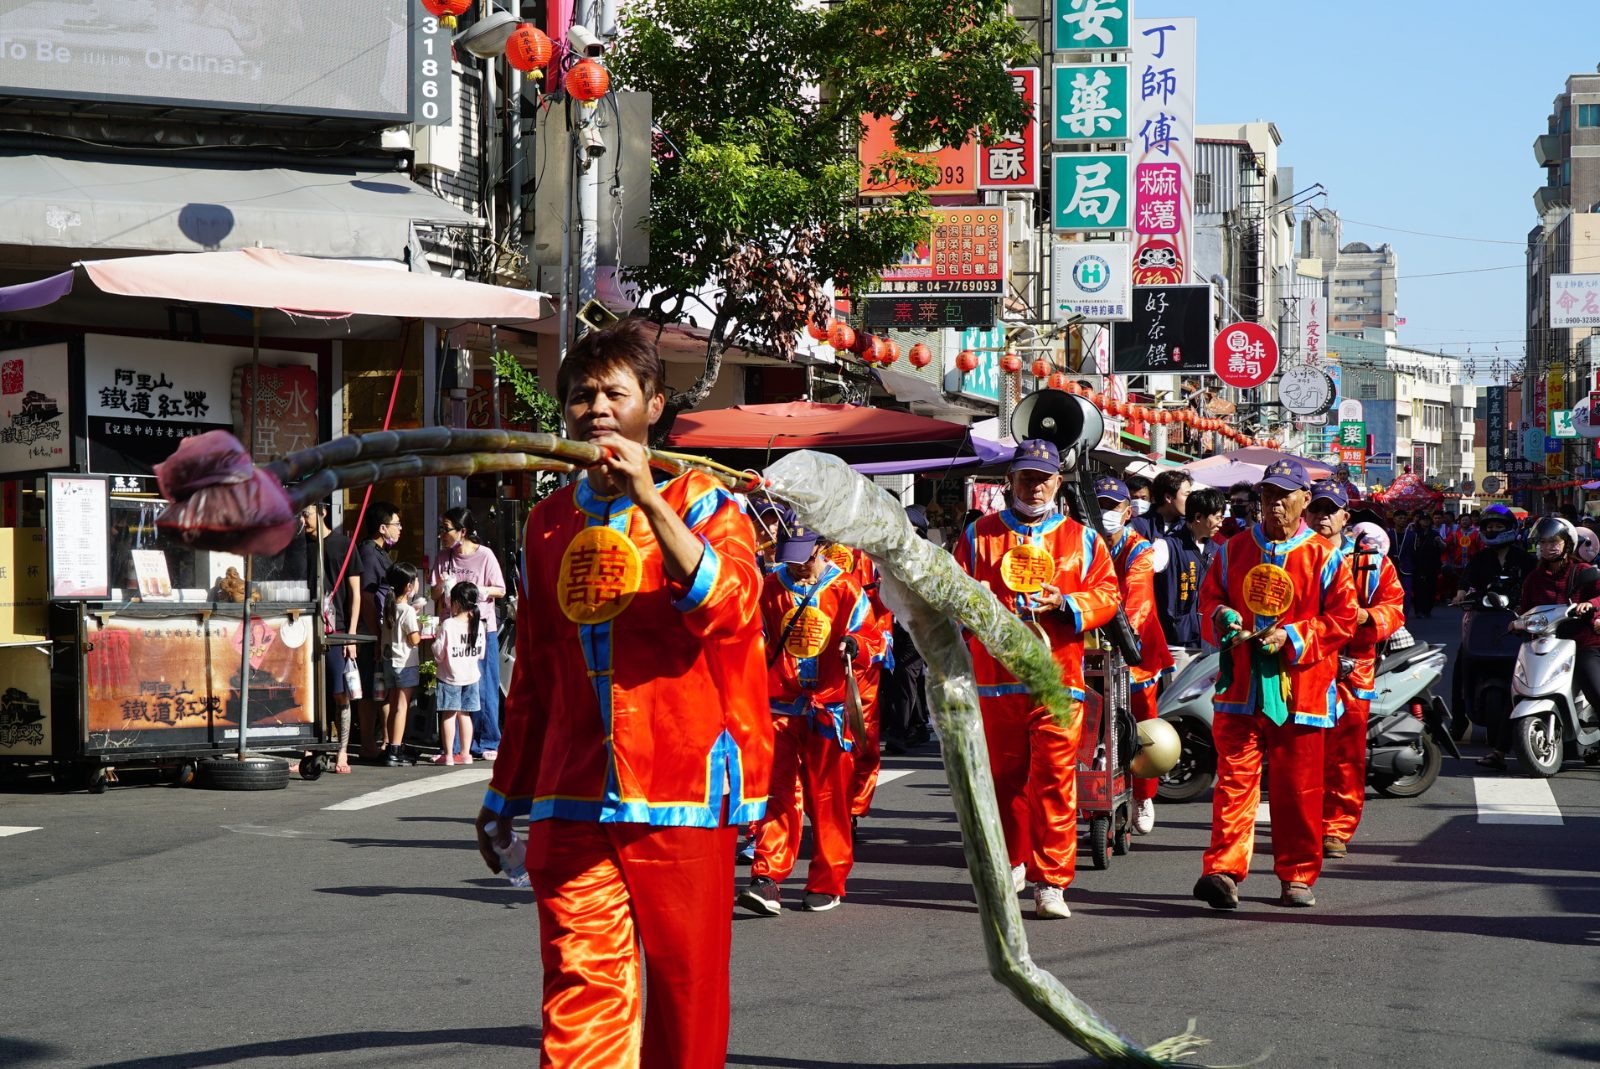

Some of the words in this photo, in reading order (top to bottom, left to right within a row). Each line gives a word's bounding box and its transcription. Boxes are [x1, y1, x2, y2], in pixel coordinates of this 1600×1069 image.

[36, 40, 71, 64] Be
[1139, 24, 1179, 156] 丁師傅
[926, 281, 997, 292] 04-7769093
[1556, 289, 1600, 315] 命名
[115, 368, 173, 390] 阿里山
[99, 386, 210, 419] 鐵道紅茶
[1343, 451, 1362, 461] 奶粉
[140, 681, 194, 699] 阿里山
[121, 696, 226, 726] 鐵道紅茶
